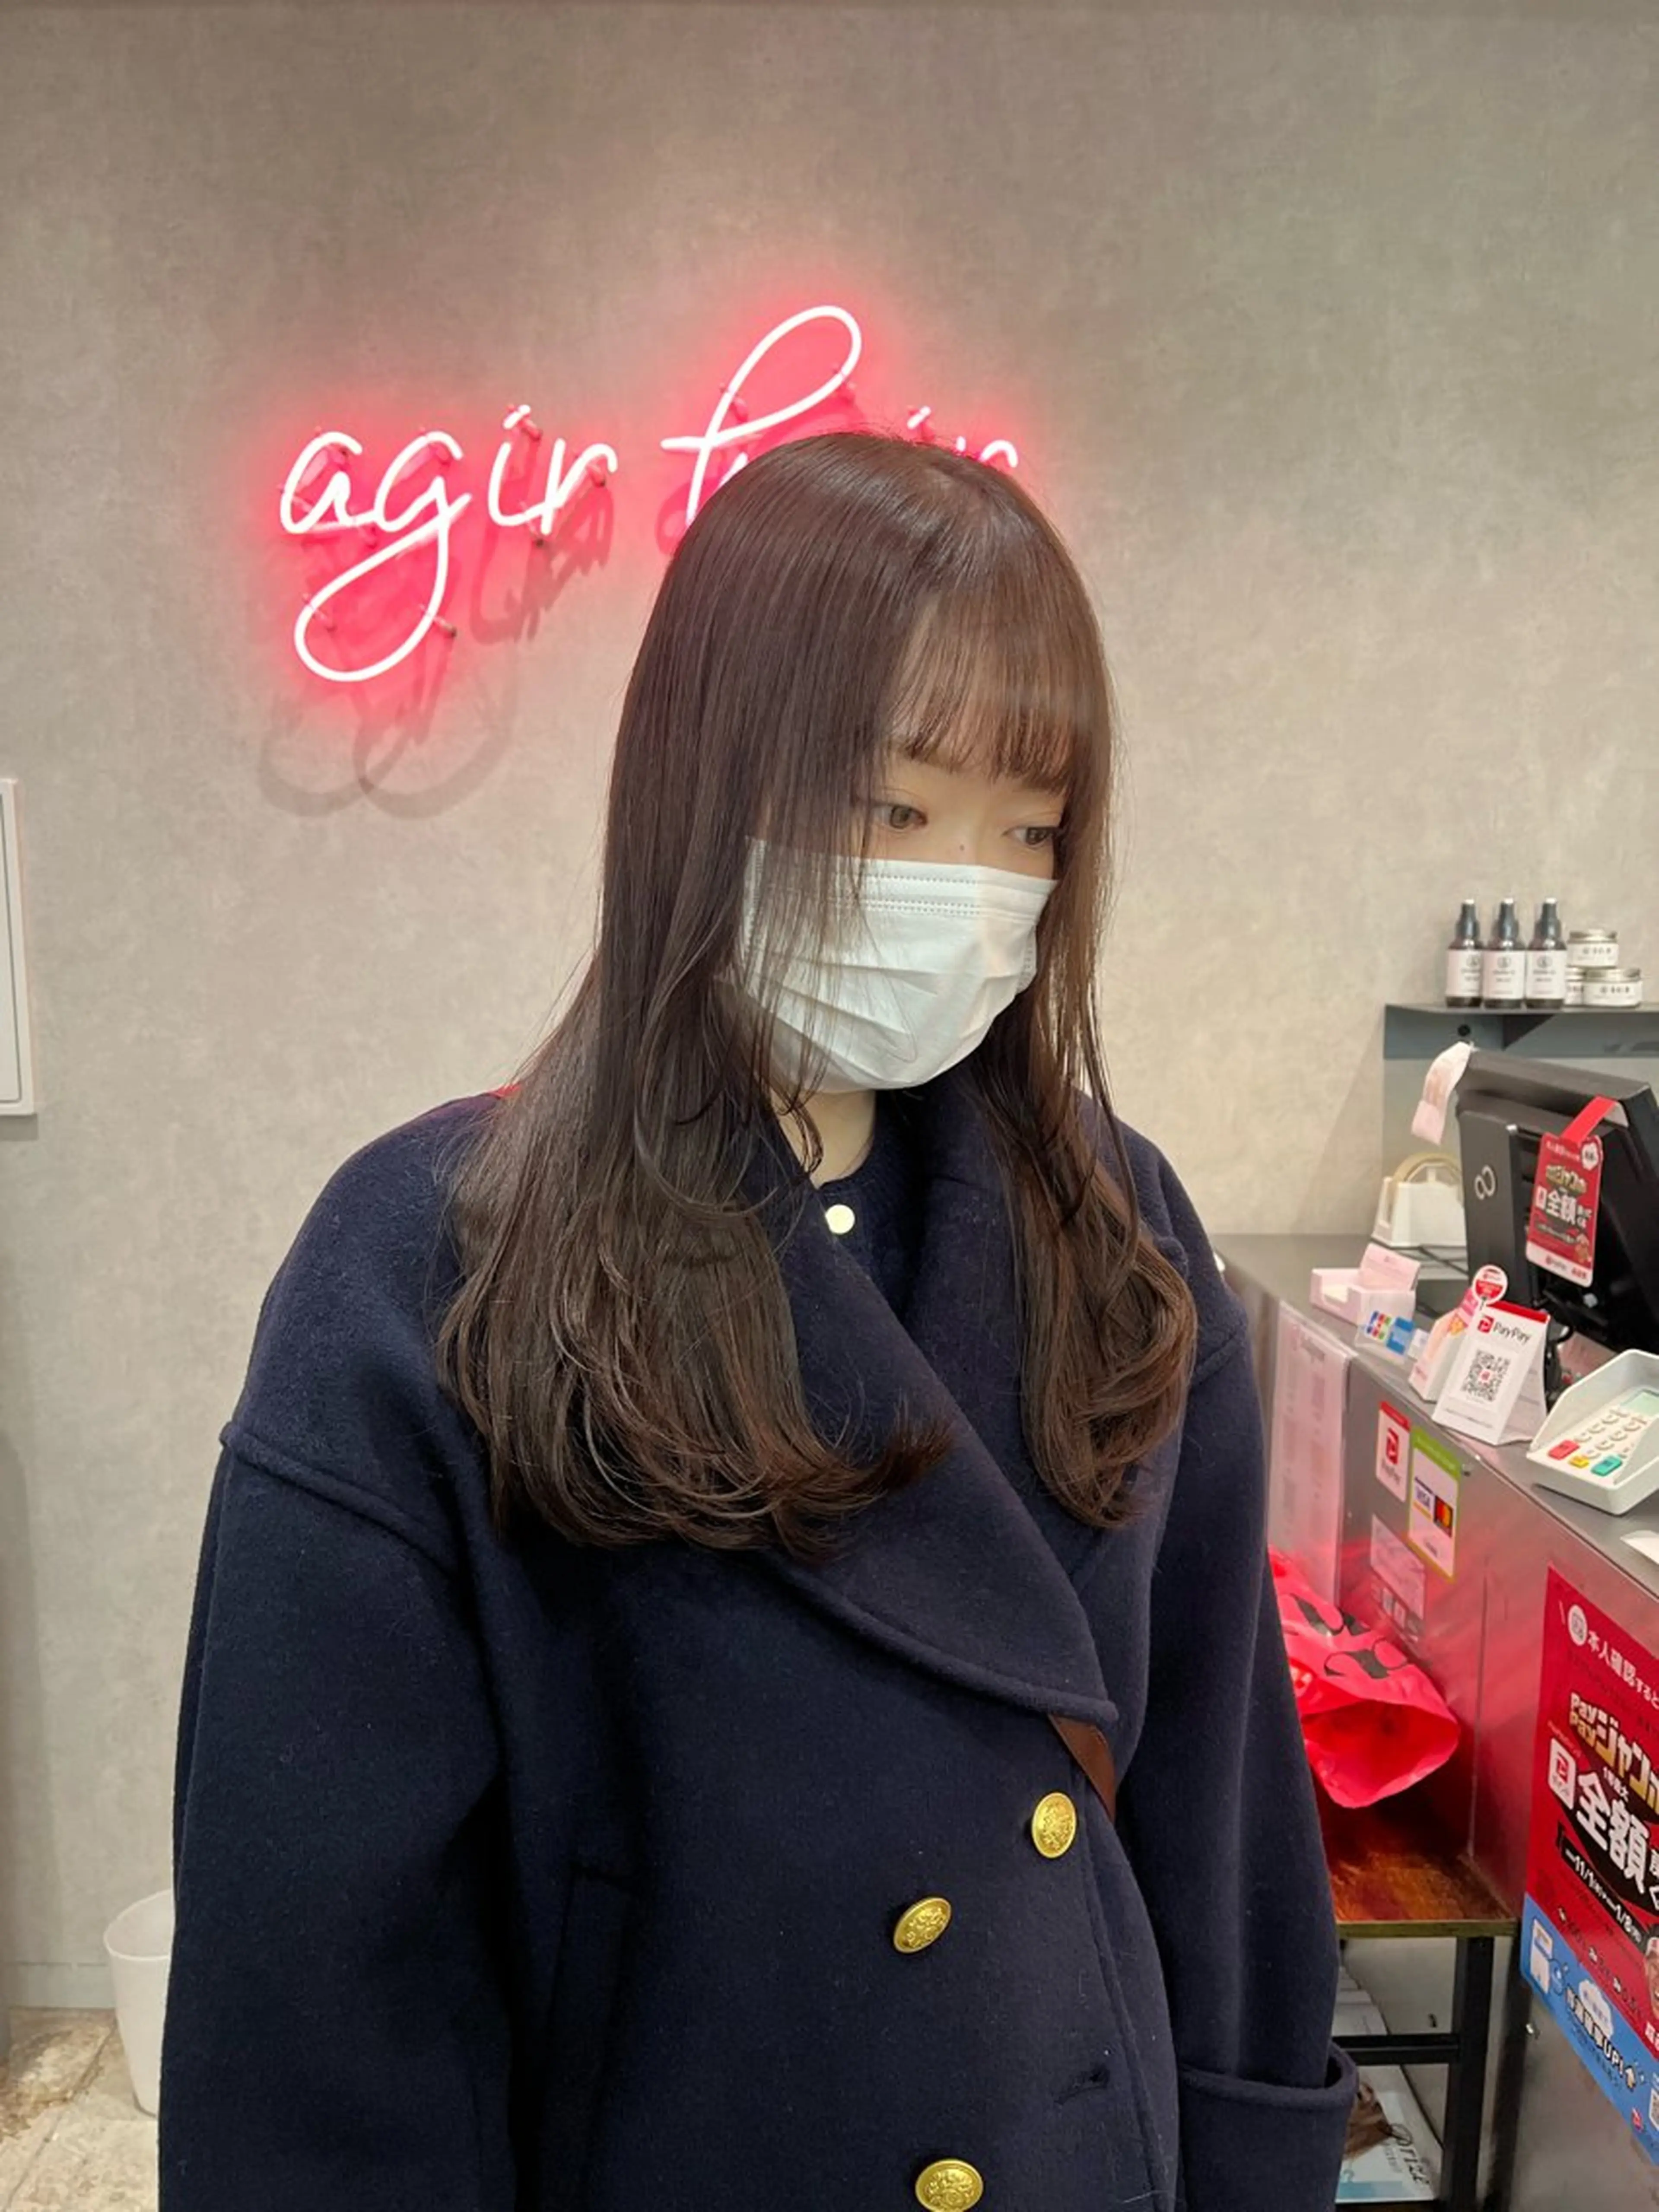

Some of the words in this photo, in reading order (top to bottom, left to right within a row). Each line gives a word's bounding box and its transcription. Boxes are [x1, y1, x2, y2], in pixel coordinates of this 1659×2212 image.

[280, 404, 617, 683] agir
[1493, 1321, 1532, 1345] PayPay
[1576, 1772, 1649, 1894] 全額
